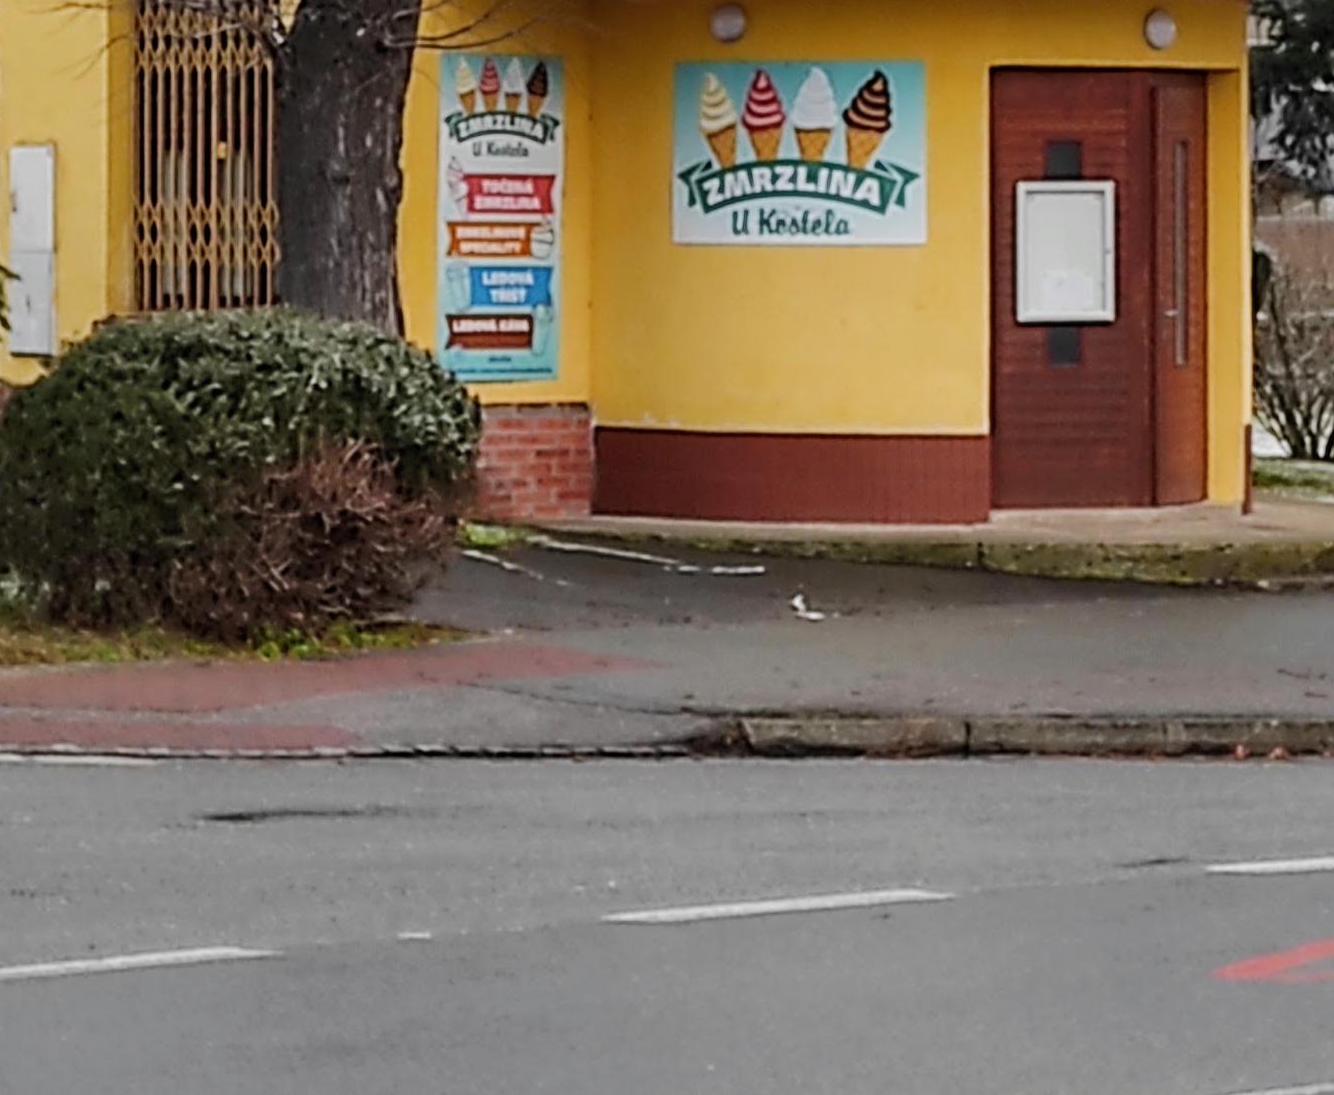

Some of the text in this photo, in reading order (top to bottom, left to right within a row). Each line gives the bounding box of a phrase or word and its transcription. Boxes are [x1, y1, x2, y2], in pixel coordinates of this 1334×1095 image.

[457, 114, 545, 139] ZMRZLINA
[472, 142, 483, 156] U
[702, 166, 882, 206] ZMRZLINA
[732, 209, 850, 235] U Kostela
